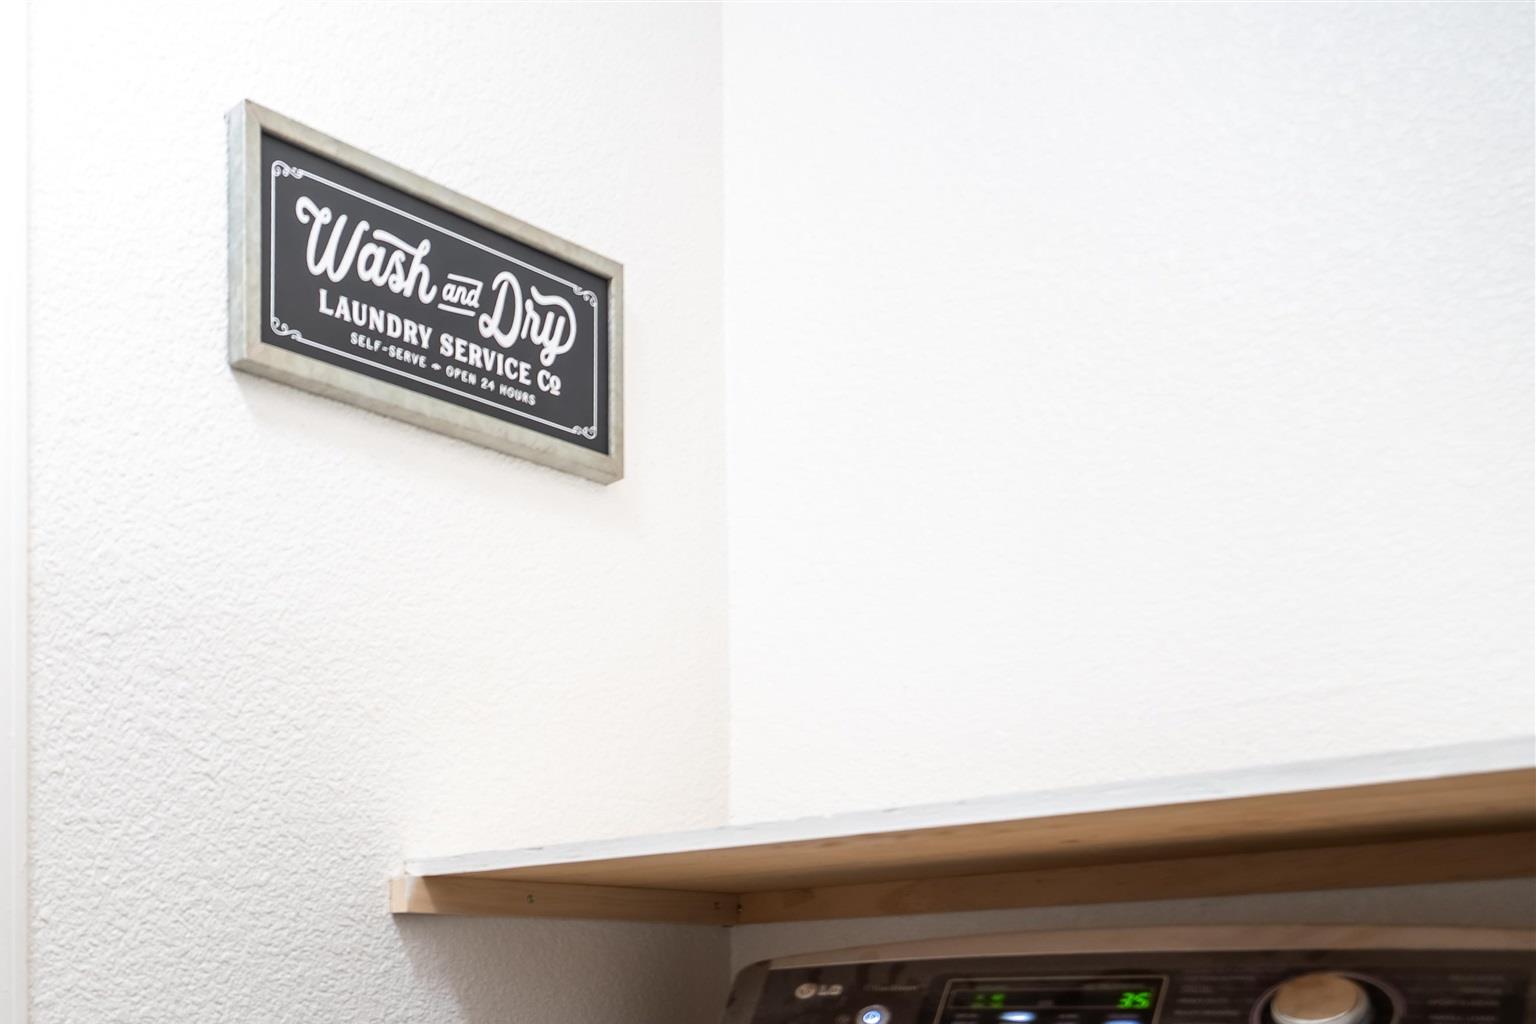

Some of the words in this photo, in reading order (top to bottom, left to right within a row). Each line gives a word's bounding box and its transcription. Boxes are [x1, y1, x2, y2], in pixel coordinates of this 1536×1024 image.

[295, 195, 438, 304] Wash
[441, 274, 484, 310] and
[478, 271, 577, 367] Dry
[318, 288, 433, 350] LAUNDRY
[439, 333, 532, 386] SERVICE
[350, 331, 427, 369] SELF-SERVE
[445, 365, 478, 386] OPEN
[480, 377, 495, 392] 24
[499, 384, 537, 406] HOURS
